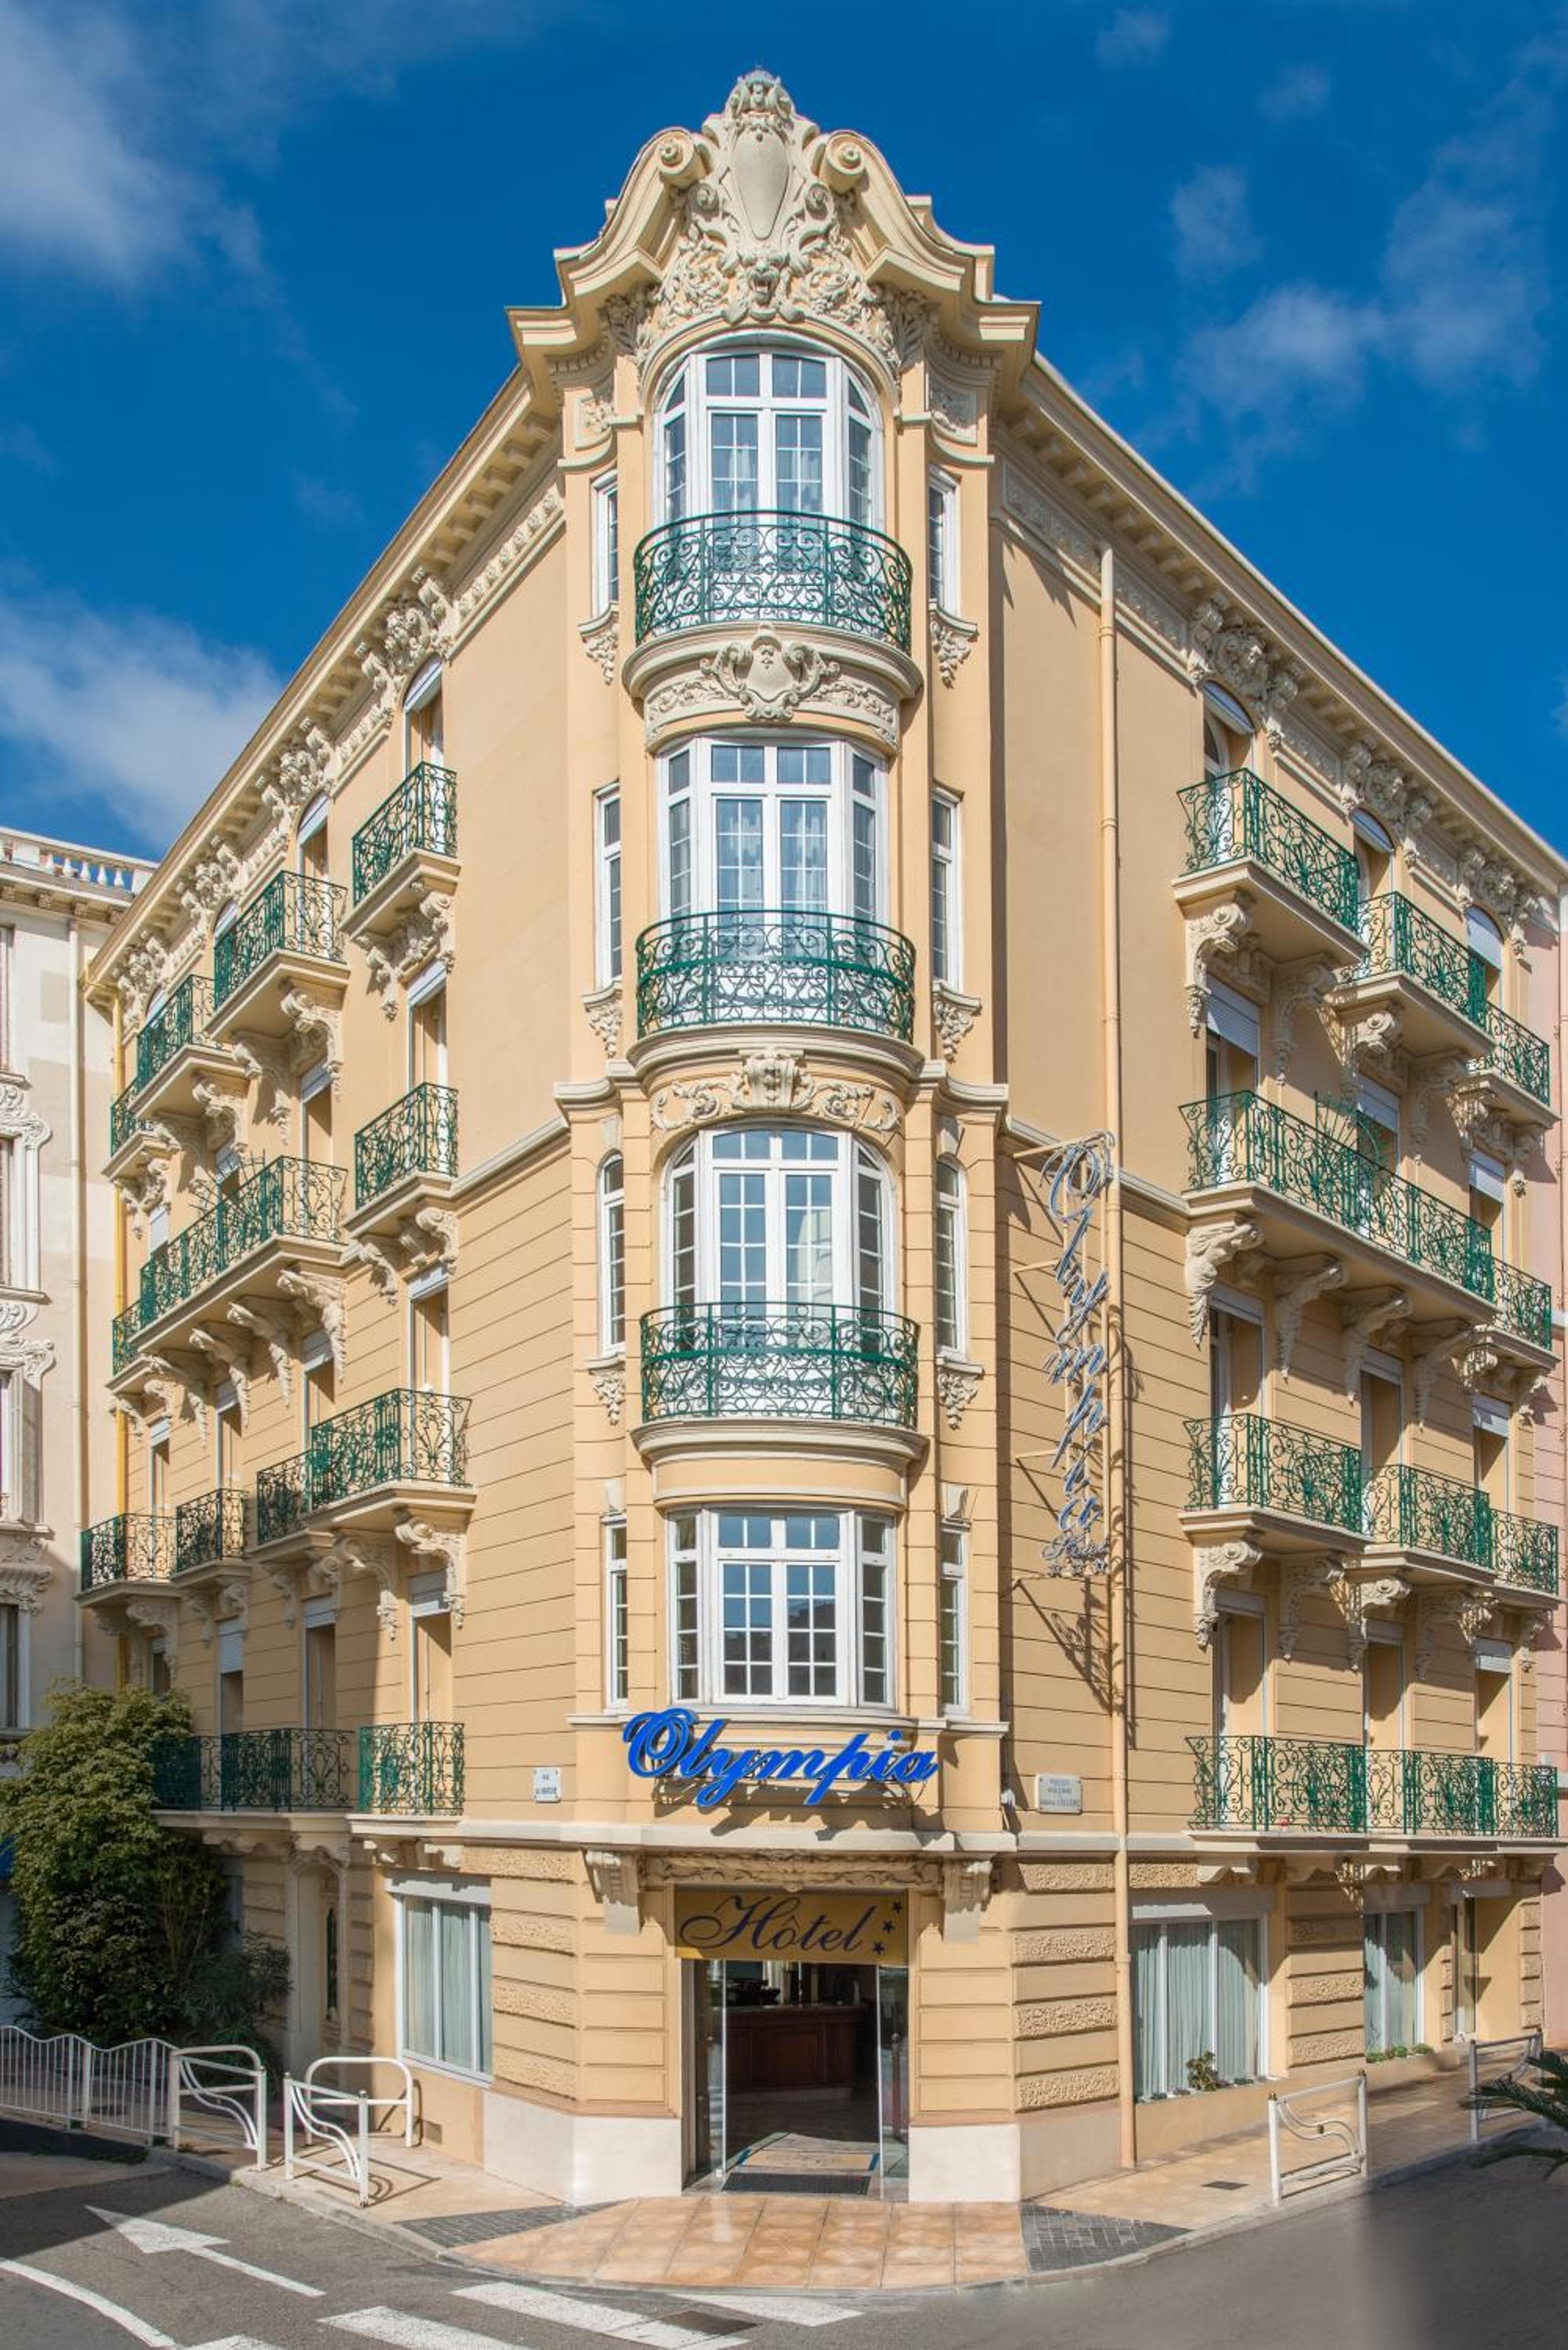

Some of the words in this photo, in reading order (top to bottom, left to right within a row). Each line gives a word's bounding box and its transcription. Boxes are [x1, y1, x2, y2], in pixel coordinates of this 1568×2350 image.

[1039, 1129, 1115, 1531] Olympia
[622, 1707, 940, 1806] Olympia
[679, 1894, 876, 1952] Hôtel
